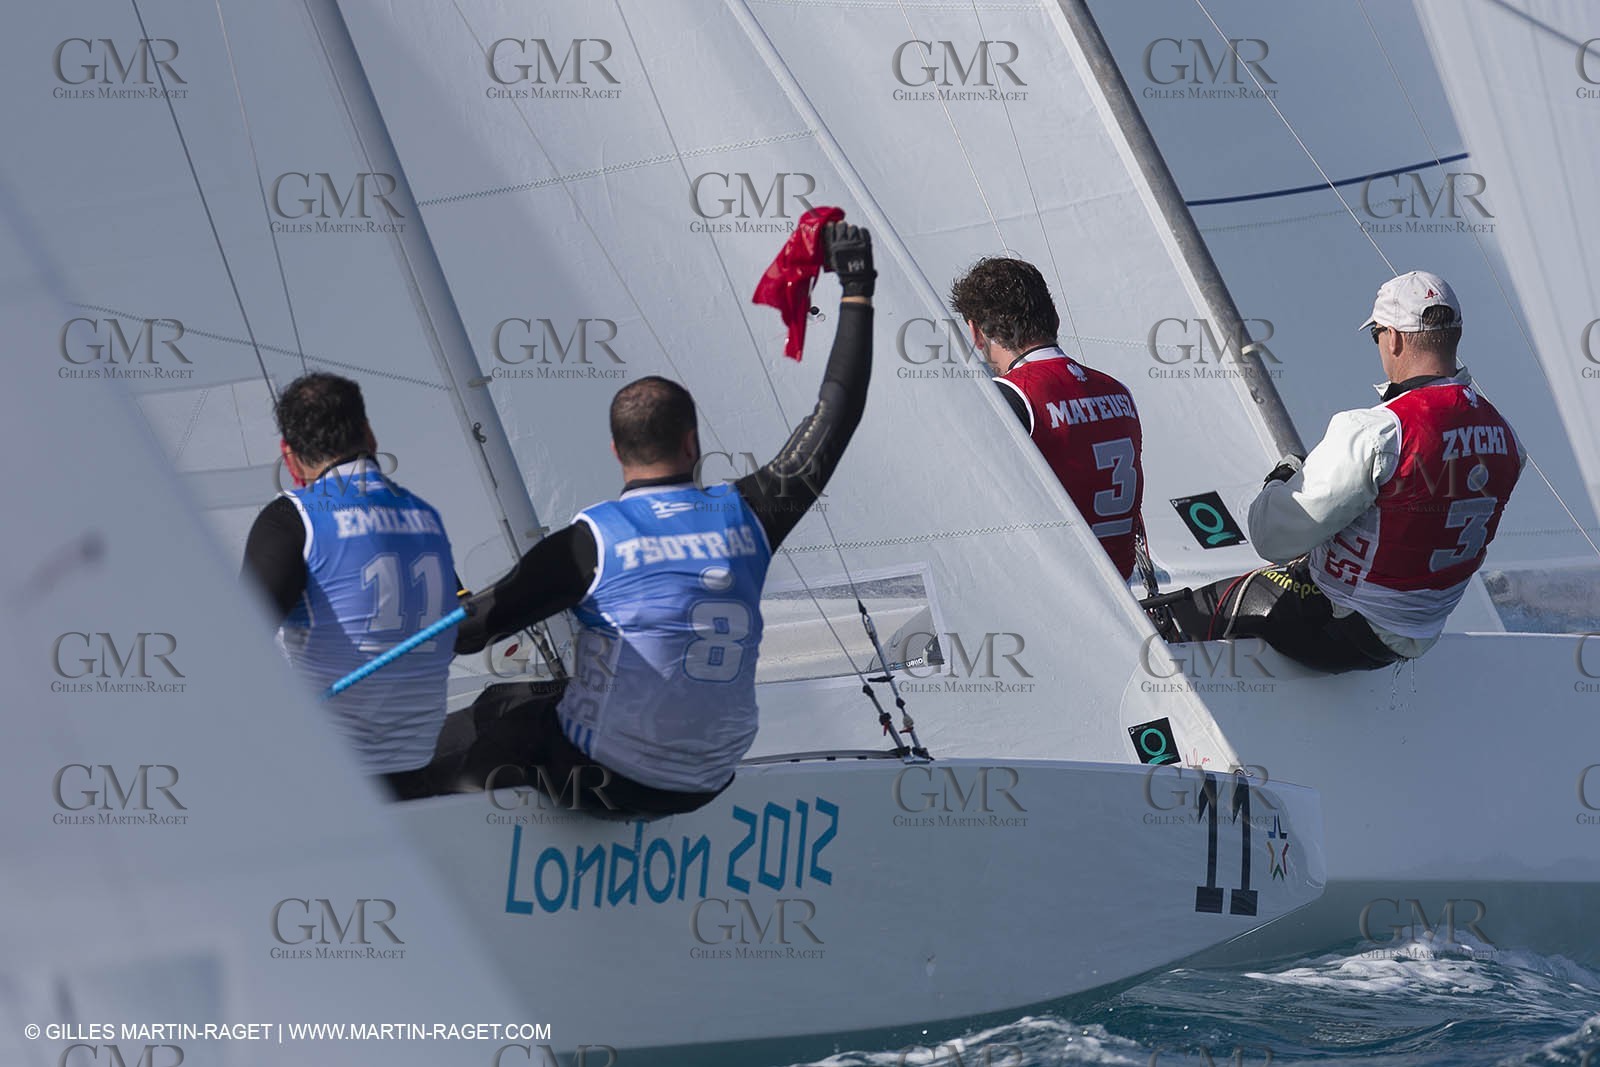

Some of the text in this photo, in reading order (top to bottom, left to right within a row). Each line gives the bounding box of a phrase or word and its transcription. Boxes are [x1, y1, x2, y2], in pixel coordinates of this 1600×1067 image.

[1046, 394, 1136, 429] MATEUSZ
[1091, 437, 1138, 517] 3
[615, 525, 756, 570] TSOTRAS
[1428, 497, 1498, 573] 3
[361, 552, 443, 633] 11
[683, 599, 752, 682] 8
[505, 797, 839, 915] London 2012
[1195, 773, 1258, 917] 11
